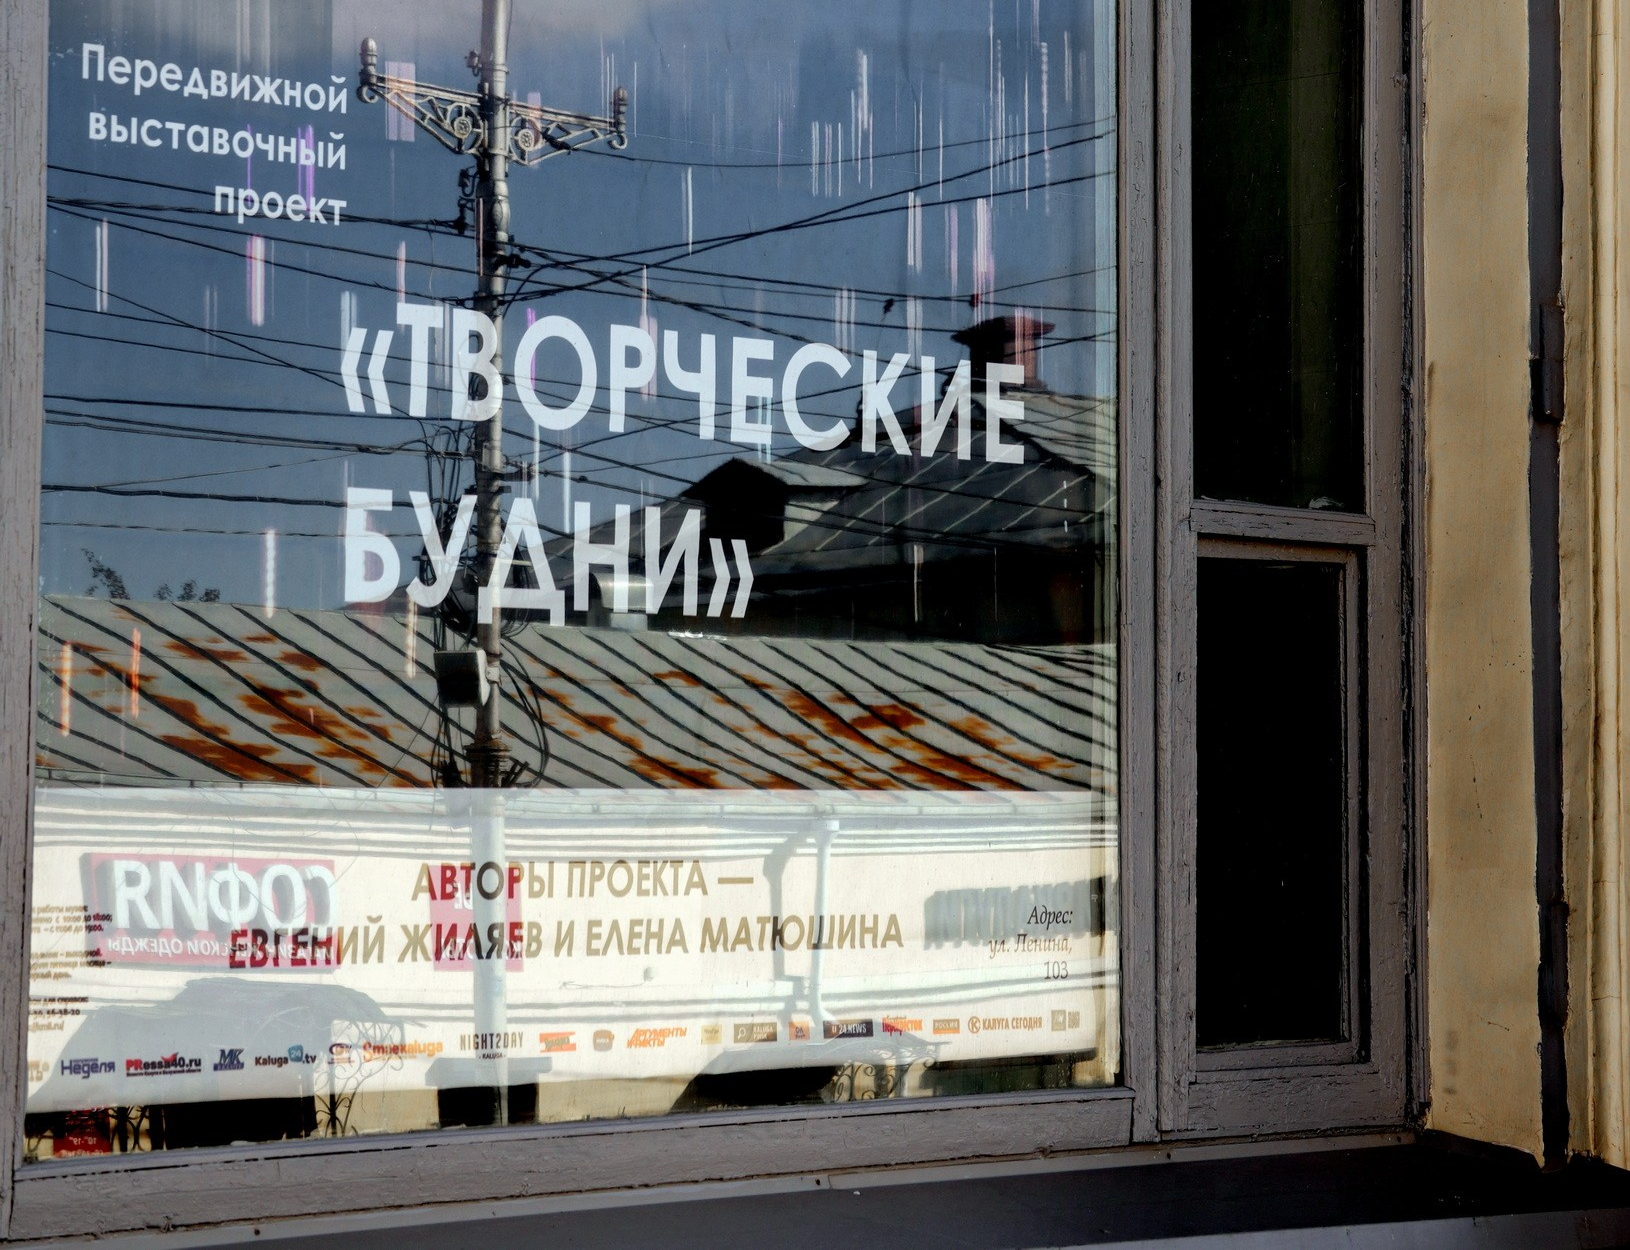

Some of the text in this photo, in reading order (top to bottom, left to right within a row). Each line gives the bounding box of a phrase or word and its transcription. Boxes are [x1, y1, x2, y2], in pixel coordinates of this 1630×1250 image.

[82, 42, 348, 114] Передвижной
[88, 112, 347, 170] выставочный
[214, 184, 348, 226] проект
[340, 302, 1026, 464] «ТВОРЧЕСКИЕ
[343, 487, 755, 627] БУДНИ»
[411, 860, 555, 901] АВТОРЫ
[567, 859, 709, 898] ПРОЕКТА
[1026, 904, 1073, 931] Адрес:
[229, 914, 385, 969] ЕВГЕНИЙ
[397, 921, 543, 963] ЖИЛЯЕВ
[554, 920, 575, 958] И
[586, 917, 690, 958] ЕЛЕНА
[699, 913, 904, 954] МАТЮШИНА
[988, 932, 1073, 959] ул. Ленина,
[1044, 960, 1069, 980] 103
[630, 1027, 687, 1041] АРГУМЕНТЫ
[982, 1017, 1009, 1031] КАЛУГА
[1012, 1016, 1043, 1031] СЕГОДНЯ
[459, 1031, 524, 1051] NIGHT2DAY
[125, 1057, 201, 1071] PRessa40.ru
